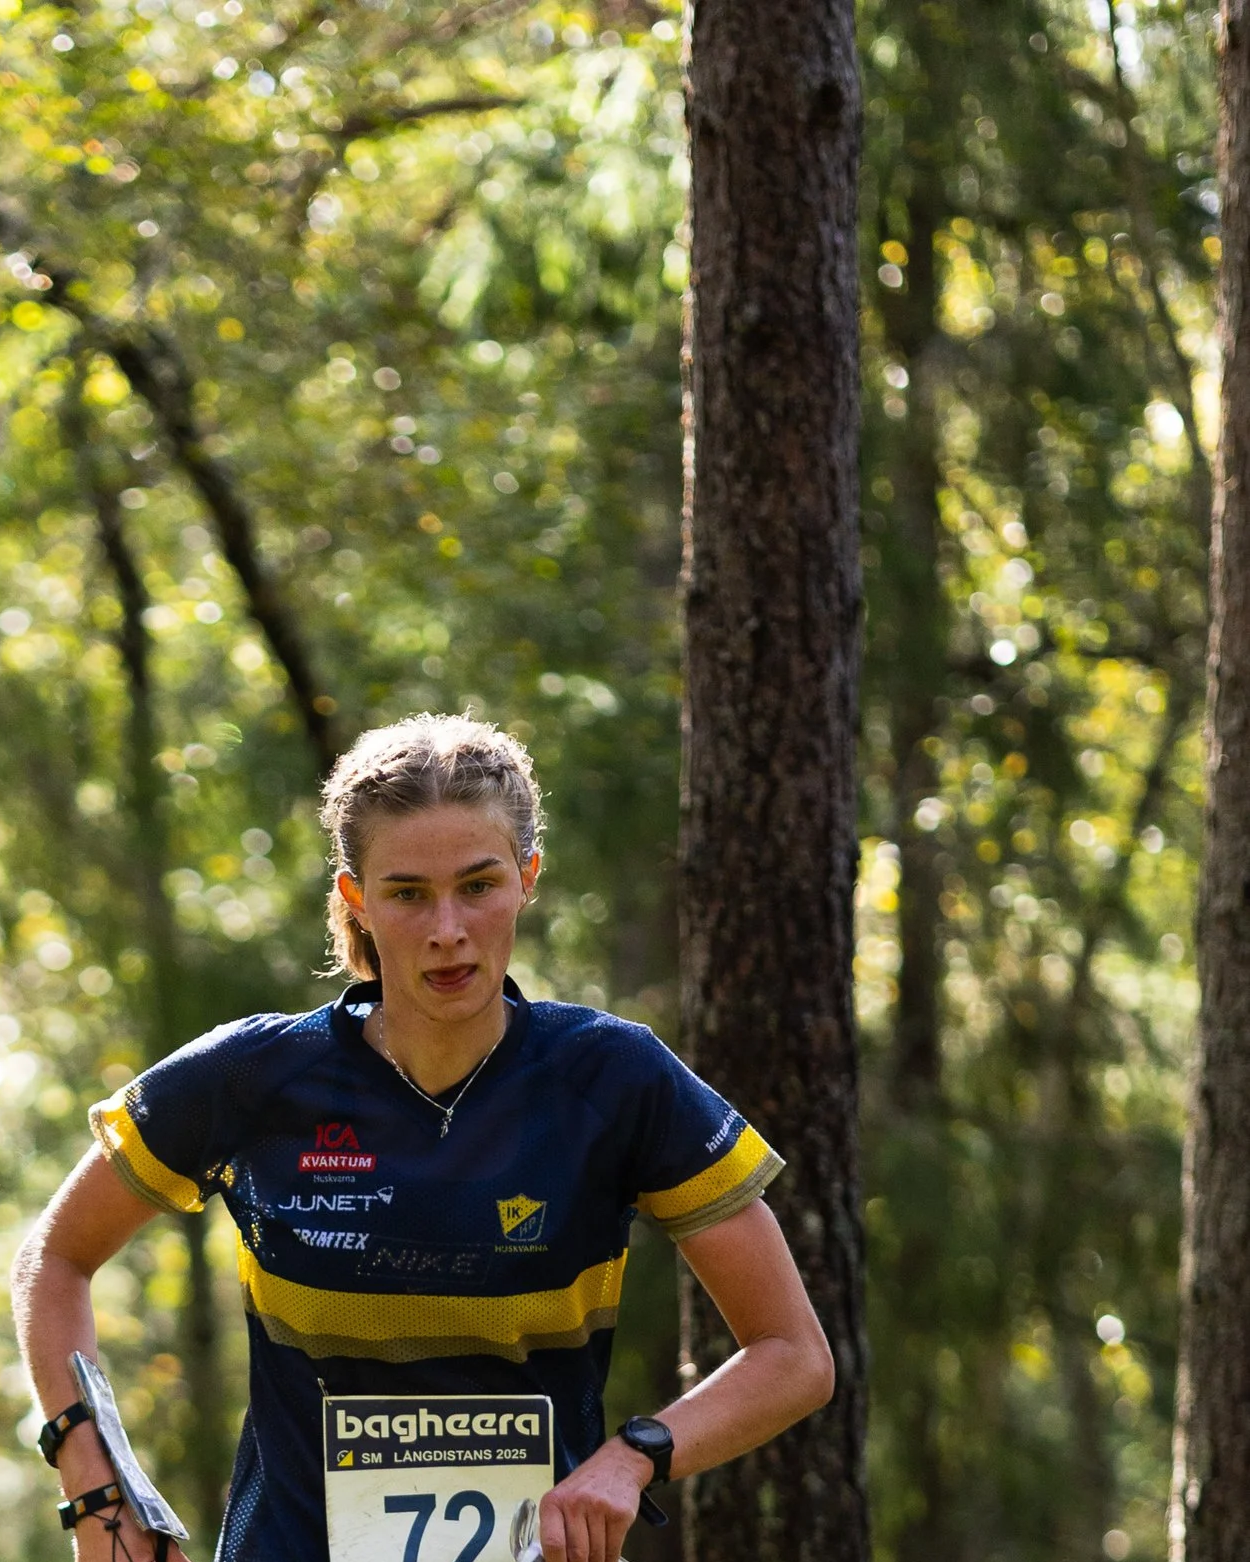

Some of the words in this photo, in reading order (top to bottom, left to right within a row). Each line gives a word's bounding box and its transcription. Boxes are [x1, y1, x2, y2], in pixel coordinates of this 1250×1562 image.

[315, 1122, 361, 1150] ICA
[301, 1155, 373, 1168] KVANTUM
[313, 1174, 356, 1183] Huskvarna
[278, 1194, 379, 1211] JUNET
[336, 1408, 540, 1443] bagheera
[361, 1452, 382, 1464] SM
[394, 1449, 493, 1463] LÅNGDISTANS
[496, 1448, 527, 1460] 2025
